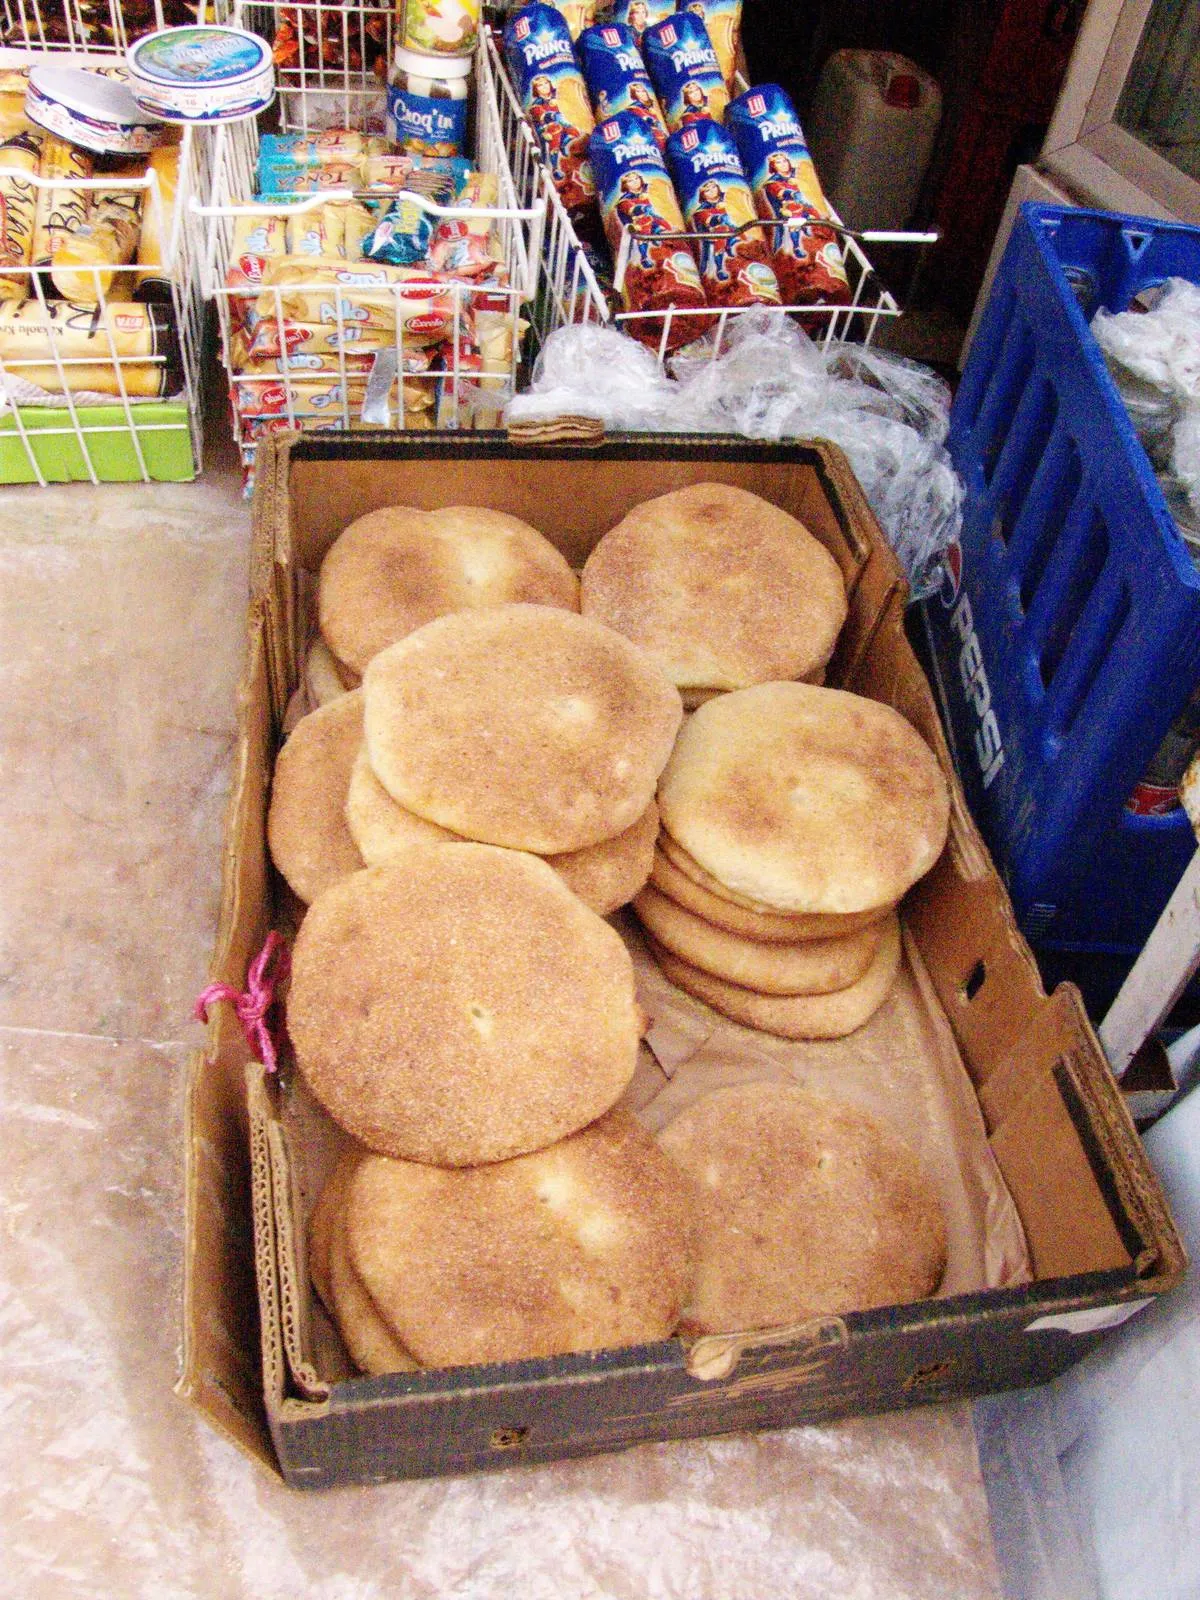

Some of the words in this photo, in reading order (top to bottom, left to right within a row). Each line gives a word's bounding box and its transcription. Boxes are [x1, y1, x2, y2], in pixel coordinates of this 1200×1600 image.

[603, 30, 620, 47] LU
[659, 26, 677, 47] LU
[748, 96, 766, 116] LU
[603, 123, 620, 142] LU
[681, 130, 699, 151] LU
